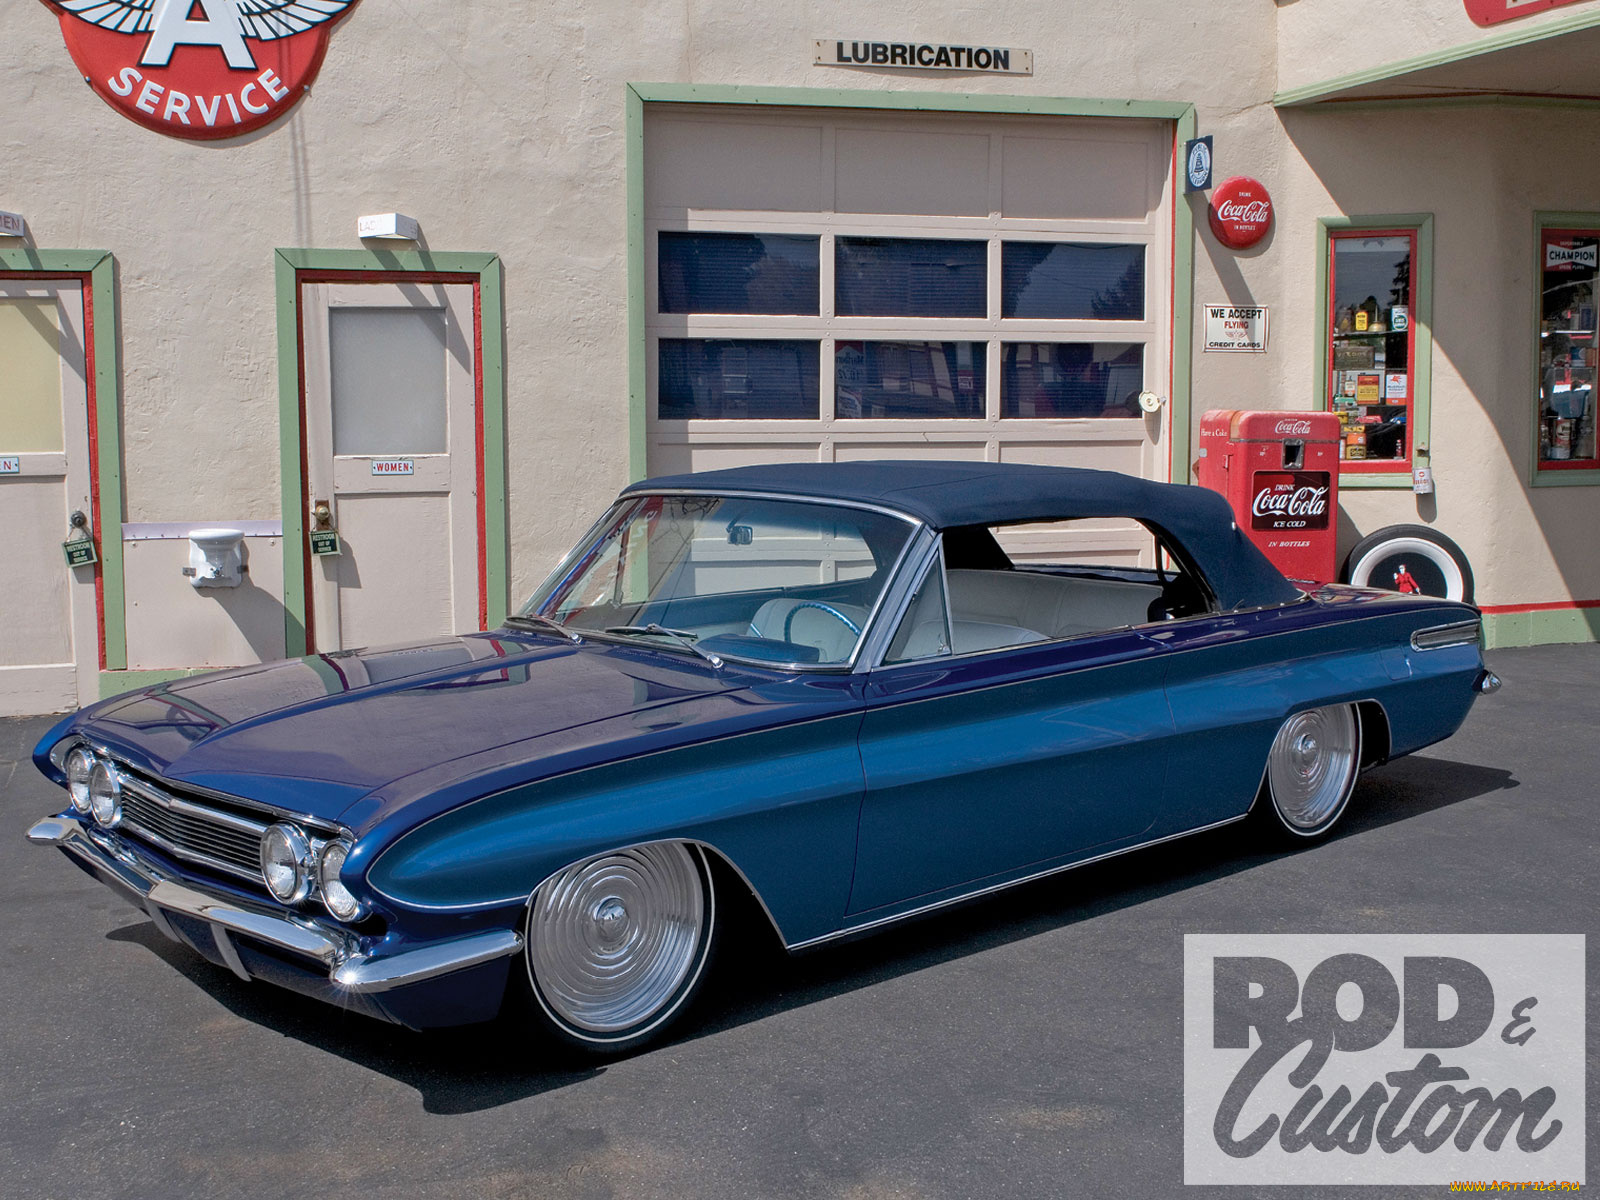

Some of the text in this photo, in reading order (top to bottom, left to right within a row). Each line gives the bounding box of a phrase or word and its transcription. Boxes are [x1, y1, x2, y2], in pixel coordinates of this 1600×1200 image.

[836, 41, 1010, 70] LUBRICATION
[107, 67, 290, 127] SERVICE
[1217, 199, 1270, 224] Coca-Cola
[1549, 250, 1595, 261] CHAMPION
[1210, 308, 1263, 320] WE ACCEPT
[1224, 320, 1249, 329] FLYING
[1274, 420, 1312, 435] Coca-Cola
[376, 461, 410, 472] WOMEN
[1252, 486, 1329, 517] Coca-Cola
[1273, 520, 1307, 528] ICE COLD
